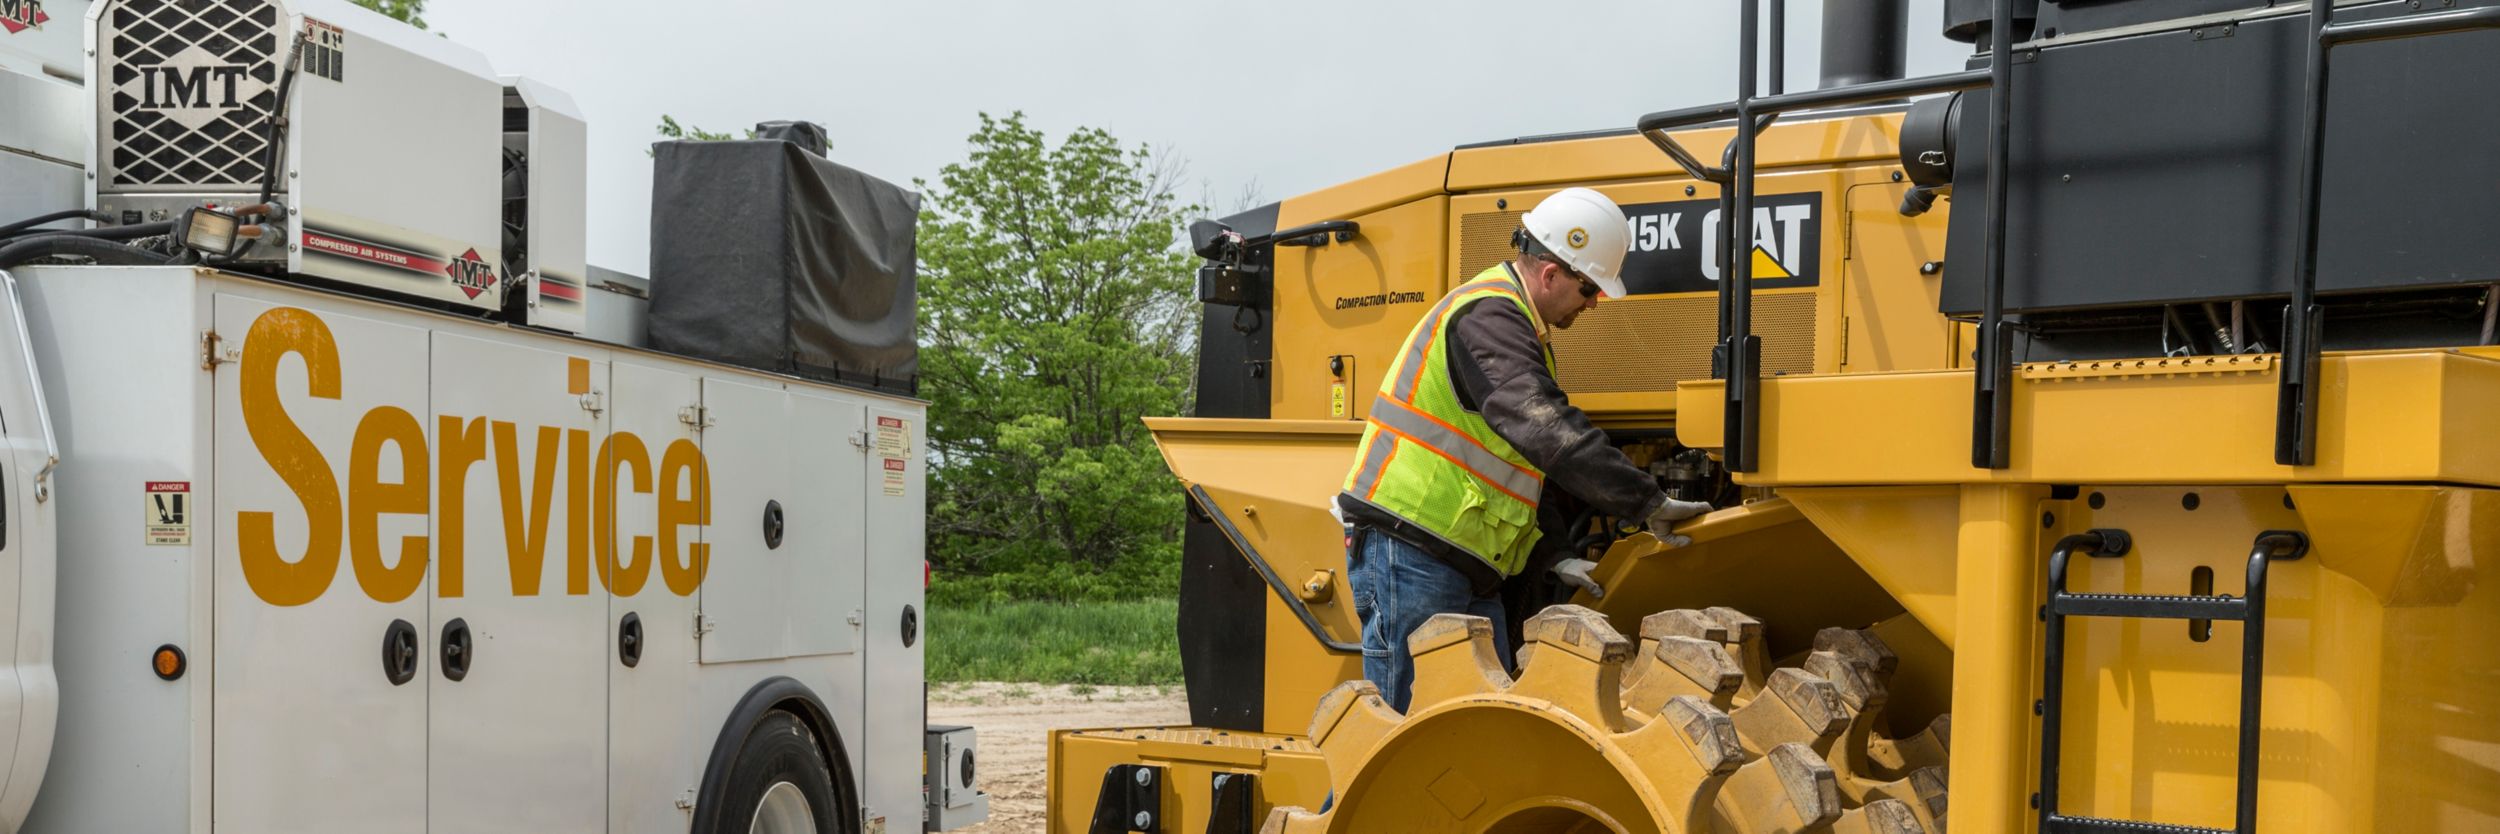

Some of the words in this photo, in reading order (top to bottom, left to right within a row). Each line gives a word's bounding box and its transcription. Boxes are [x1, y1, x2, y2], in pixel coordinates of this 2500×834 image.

[0, 0, 41, 27] MT
[140, 66, 247, 108] IMT
[310, 237, 358, 254] COMPRESSED
[361, 249, 373, 257] AIR
[376, 251, 407, 264] SYSTEMS
[1628, 212, 1682, 252] 15K
[1701, 204, 1810, 280] CAT
[452, 257, 491, 290] IMT
[237, 305, 712, 608] Service
